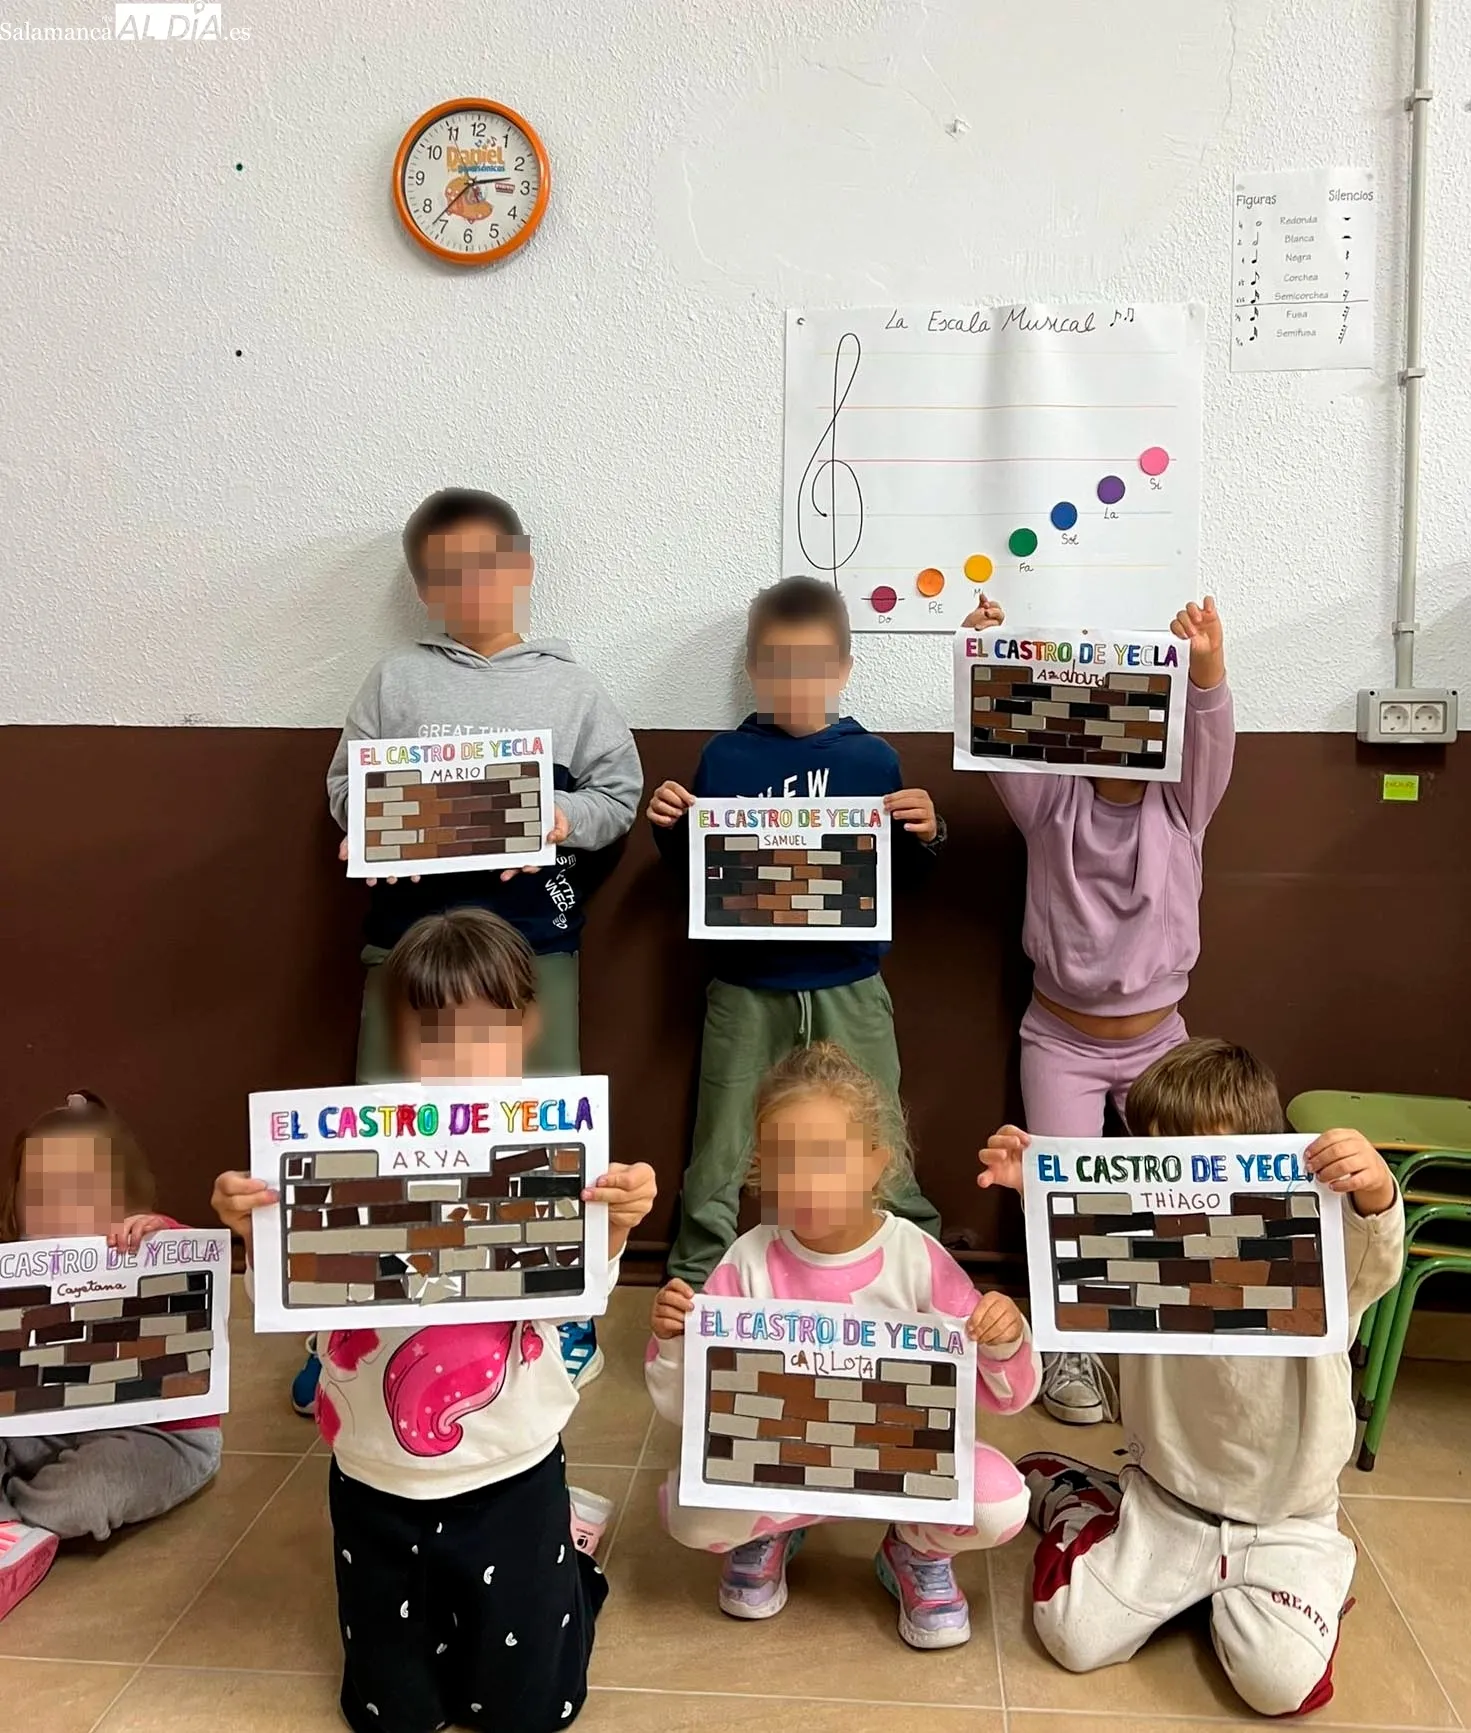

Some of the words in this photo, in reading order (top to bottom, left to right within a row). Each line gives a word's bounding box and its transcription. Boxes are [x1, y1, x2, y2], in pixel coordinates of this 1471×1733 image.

[471, 122, 487, 138] 12
[503, 134, 509, 148] 1
[427, 145, 442, 161] 10
[446, 145, 505, 170] Daniel
[514, 156, 525, 172] 2
[415, 170, 425, 185] 9
[520, 180, 530, 196] 3
[1328, 188, 1374, 202] Silencios
[423, 198, 432, 213] 8
[1236, 193, 1277, 210] Figuras
[507, 206, 518, 220] 4
[1279, 215, 1318, 226] Redonda
[439, 219, 449, 234] 7
[489, 223, 499, 239] 5
[463, 228, 473, 244] 6
[1284, 234, 1315, 244] Blanca
[1285, 252, 1312, 264] Negra
[1283, 273, 1319, 283] Corchea
[1274, 290, 1329, 301] Semicorchea
[885, 309, 908, 329] La
[927, 309, 991, 333] Escala
[1001, 306, 1096, 333] Musical
[1286, 309, 1308, 319] Fusa
[1276, 327, 1317, 338] Semifusa
[1104, 507, 1119, 521] La
[1061, 532, 1080, 546] Sol
[1019, 561, 1034, 573] Fa
[928, 601, 944, 615] RE
[878, 615, 892, 624] Do
[965, 638, 989, 658] EL
[994, 639, 1073, 663] CASTRO
[1079, 643, 1106, 665] DE
[1114, 644, 1179, 668] YECLA
[418, 724, 474, 738] GREAT
[360, 747, 381, 766] EL
[386, 743, 455, 764] CASTRO
[461, 741, 484, 761] DE
[490, 736, 544, 758] YECLA
[430, 767, 481, 783] MARIO
[698, 809, 720, 829] EL
[724, 809, 793, 828] CASTRO
[799, 809, 821, 828] DE
[827, 808, 882, 828] YECLA
[764, 834, 807, 846] SAMUEL
[271, 1110, 308, 1141] EL
[317, 1104, 439, 1139] CASTRO
[448, 1103, 491, 1136] DE
[500, 1097, 594, 1133] YECLA
[392, 1150, 470, 1169] ARYA
[1037, 1154, 1069, 1183] EL
[1076, 1154, 1181, 1184] CASTRO
[1191, 1154, 1228, 1183] DE
[1236, 1153, 1314, 1183] YECL
[0, 1247, 98, 1279] CASTRO
[106, 1247, 138, 1271] DE
[145, 1239, 222, 1267] YECLA
[57, 1279, 127, 1298] Cayetana
[700, 1308, 729, 1338] EL
[736, 1310, 835, 1345] CASTRO
[842, 1318, 876, 1348] DE
[885, 1321, 965, 1355] YECLA
[1271, 1591, 1329, 1637] CREATE
